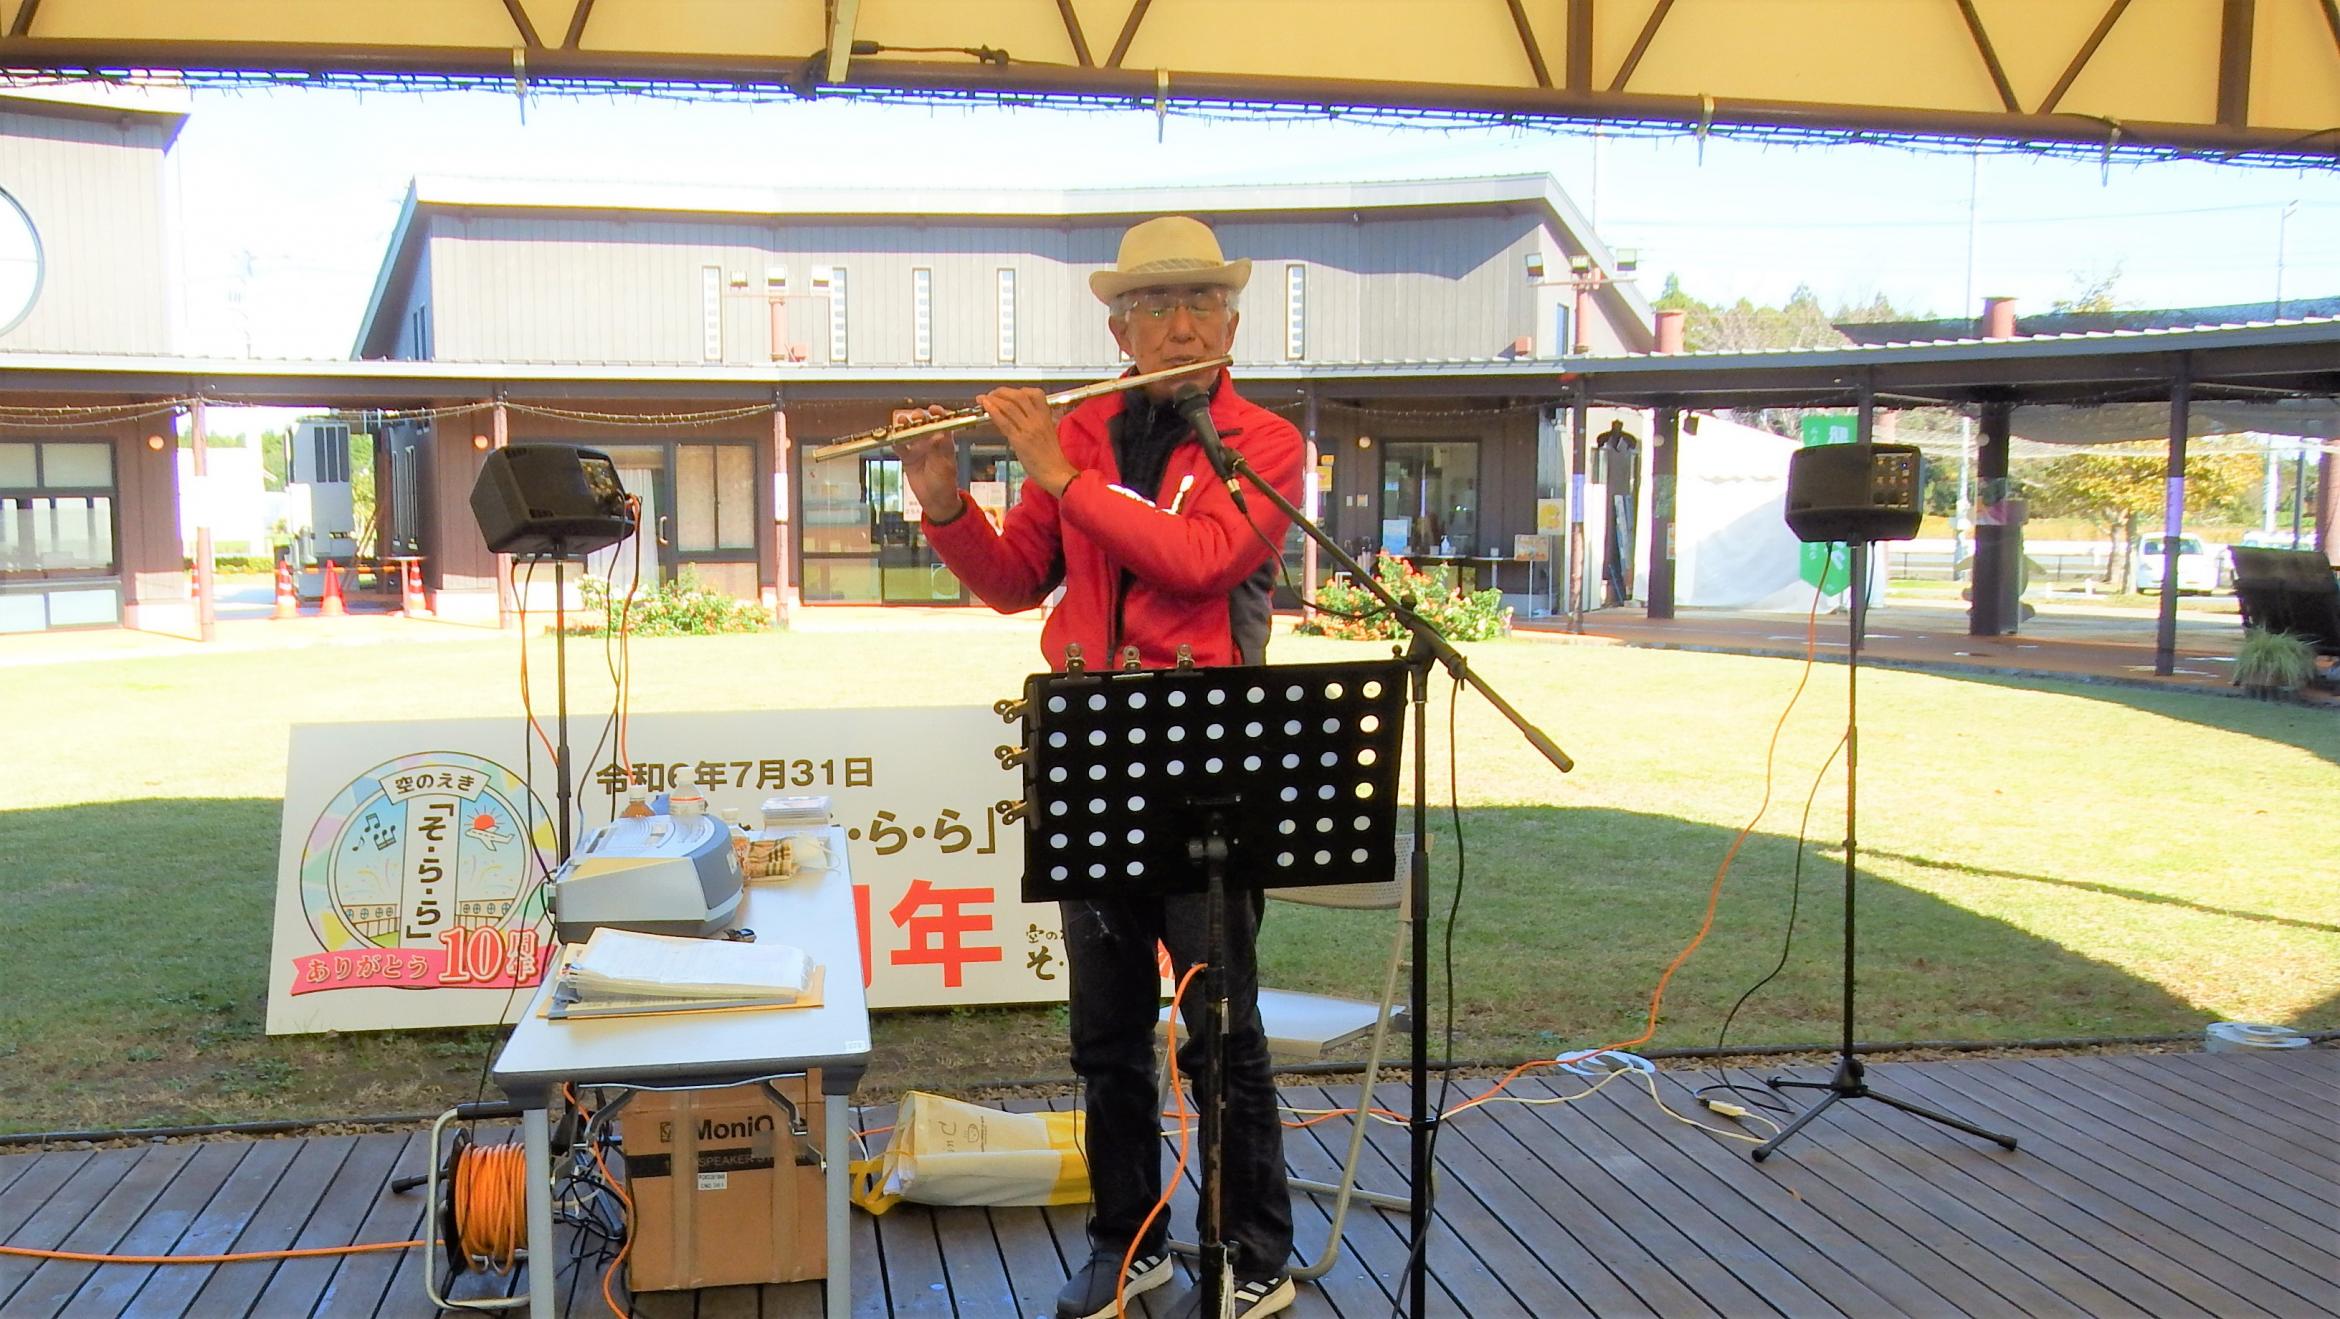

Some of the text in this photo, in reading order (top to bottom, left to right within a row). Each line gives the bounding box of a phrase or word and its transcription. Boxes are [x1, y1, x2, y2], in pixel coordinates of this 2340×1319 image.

[395, 773, 475, 794] 空のえき
[852, 879, 1003, 989] 年
[1026, 923, 1065, 944] 空の
[305, 954, 428, 983] ありがとう
